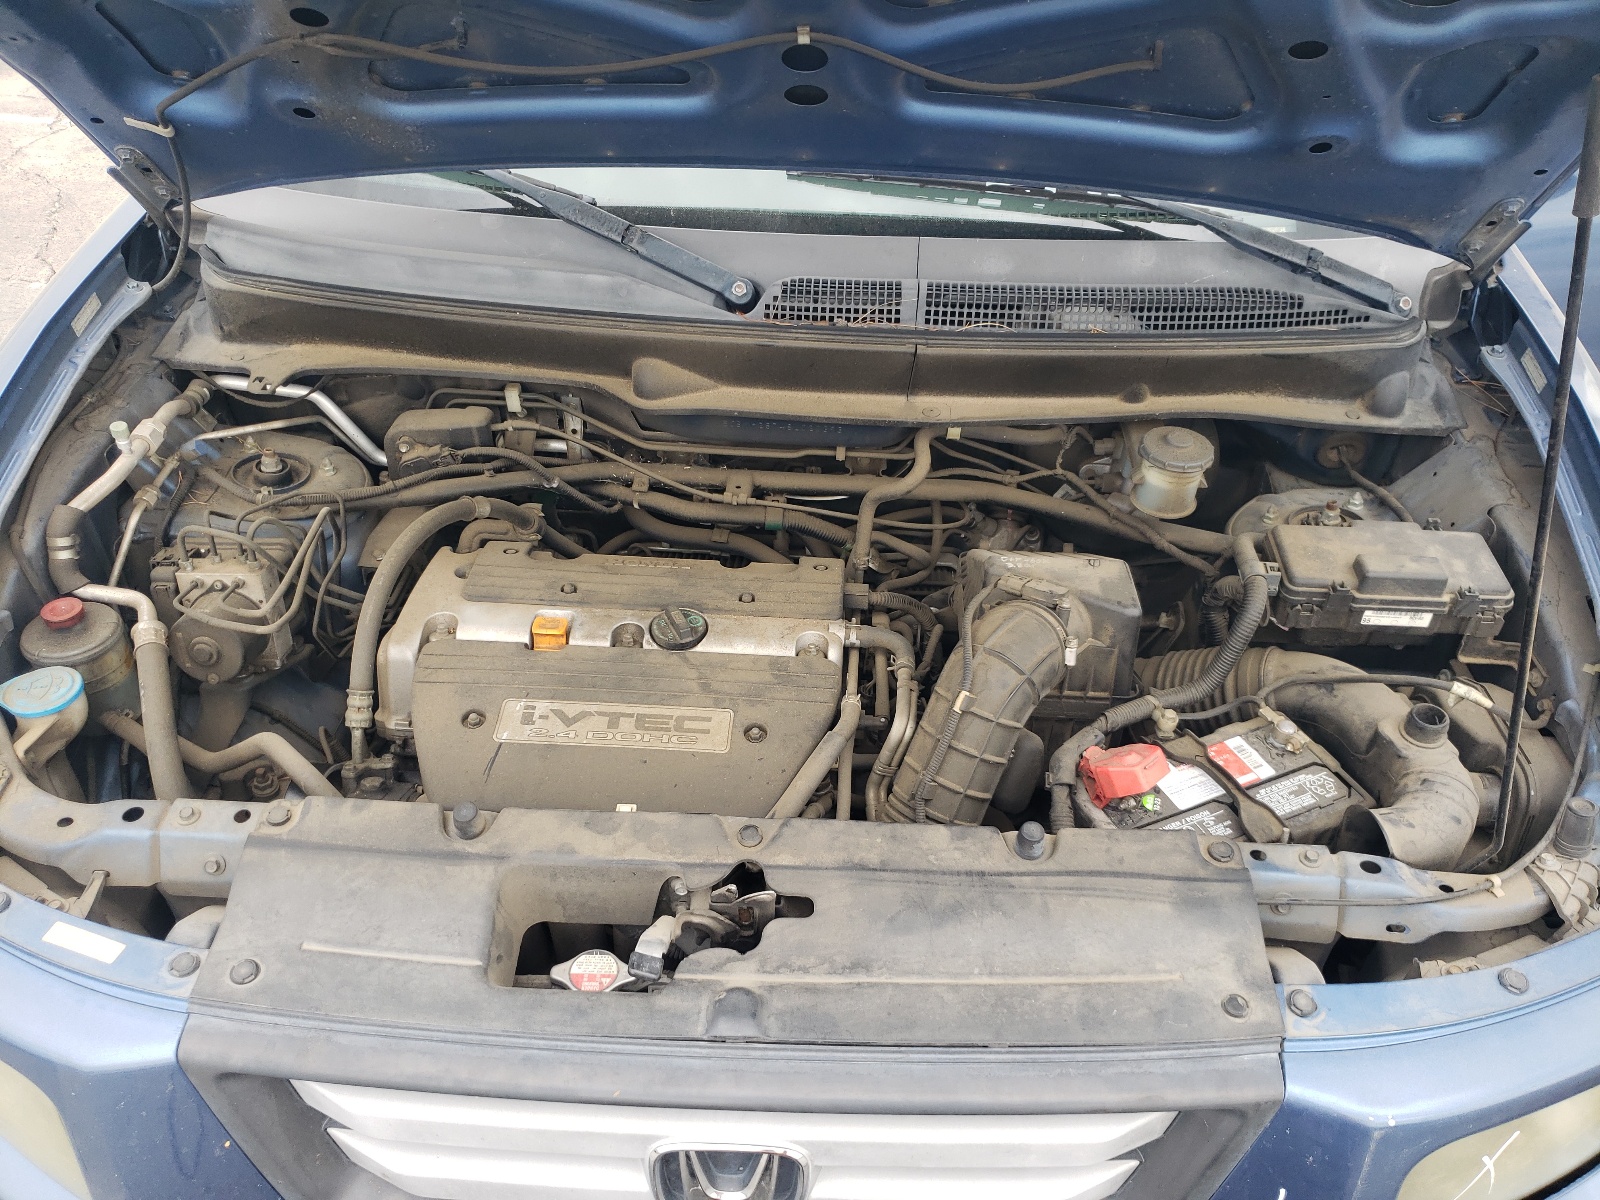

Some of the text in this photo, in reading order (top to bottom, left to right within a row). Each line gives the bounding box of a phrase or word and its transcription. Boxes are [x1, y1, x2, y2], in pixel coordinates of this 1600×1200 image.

[520, 704, 713, 735] i-VTEC
[528, 727, 698, 745] 2.4 DOHC
[1185, 810, 1211, 822] POISON
